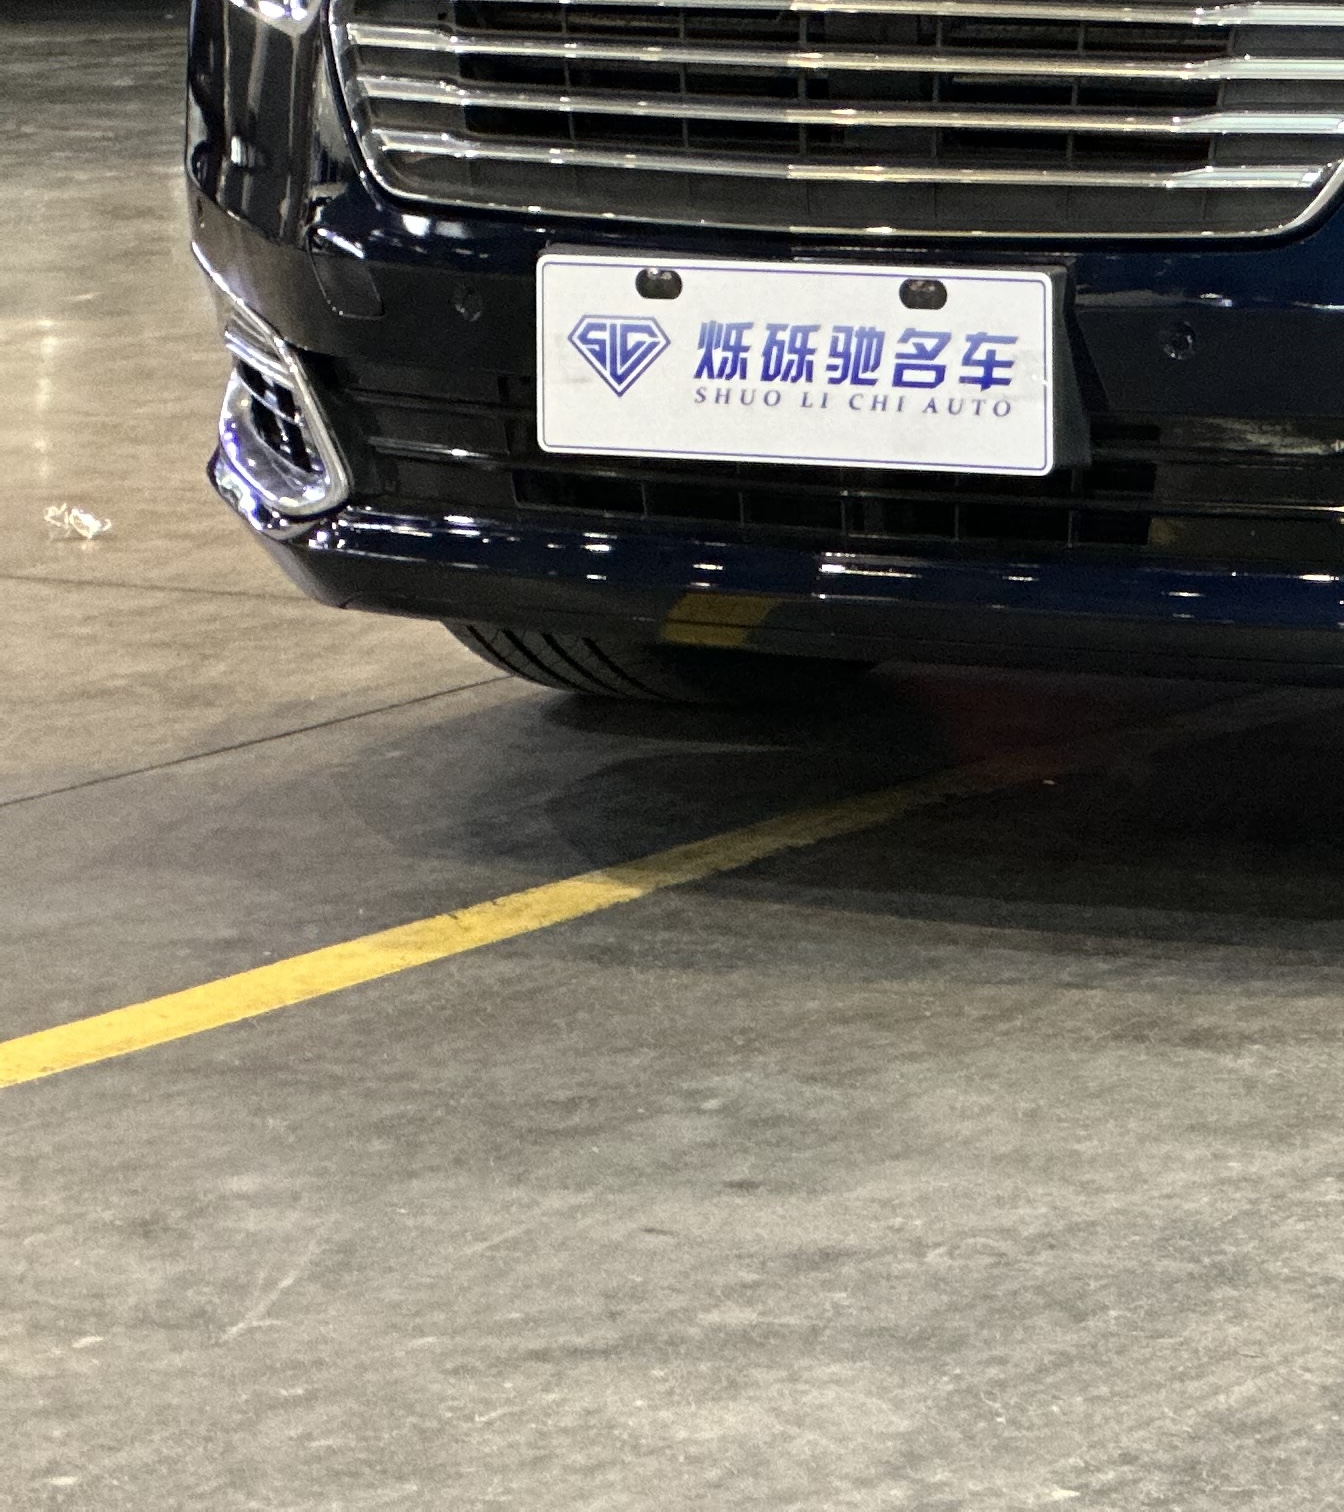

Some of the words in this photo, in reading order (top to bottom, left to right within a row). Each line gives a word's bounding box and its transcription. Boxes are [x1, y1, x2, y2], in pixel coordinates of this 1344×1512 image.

[694, 320, 1019, 392] 烁砾驰名车
[693, 386, 782, 408] SHUO
[800, 393, 830, 410] LI
[848, 393, 905, 412] CHI
[922, 399, 1012, 419] AUTO
